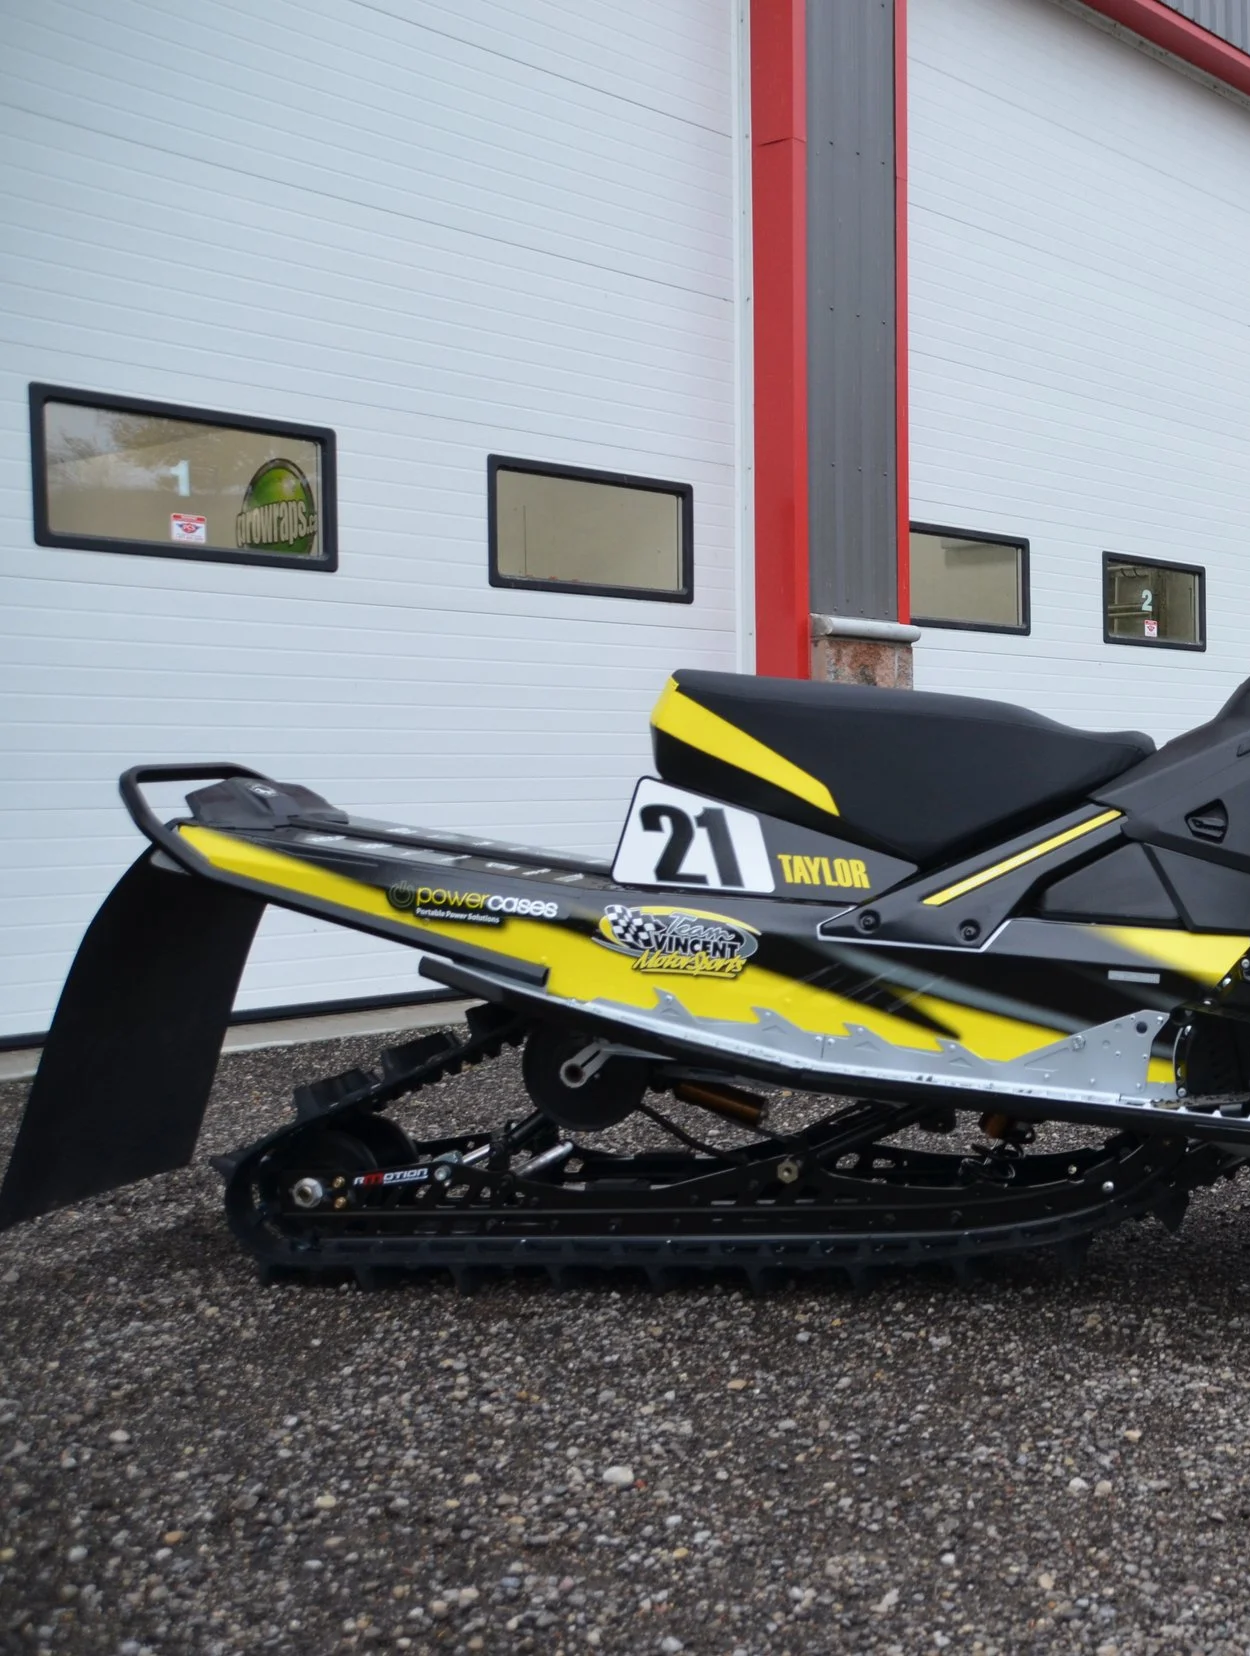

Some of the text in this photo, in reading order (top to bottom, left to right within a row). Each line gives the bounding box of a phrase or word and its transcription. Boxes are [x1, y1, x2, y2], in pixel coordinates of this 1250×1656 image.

[170, 460, 190, 496] 1
[1141, 589, 1152, 611] 2
[639, 803, 744, 889] 21
[777, 853, 871, 889] TAYLOR
[416, 886, 558, 918] powercases
[416, 907, 500, 924] Portable Power Solutions
[667, 911, 735, 941] Team
[654, 934, 741, 959] VINCENT
